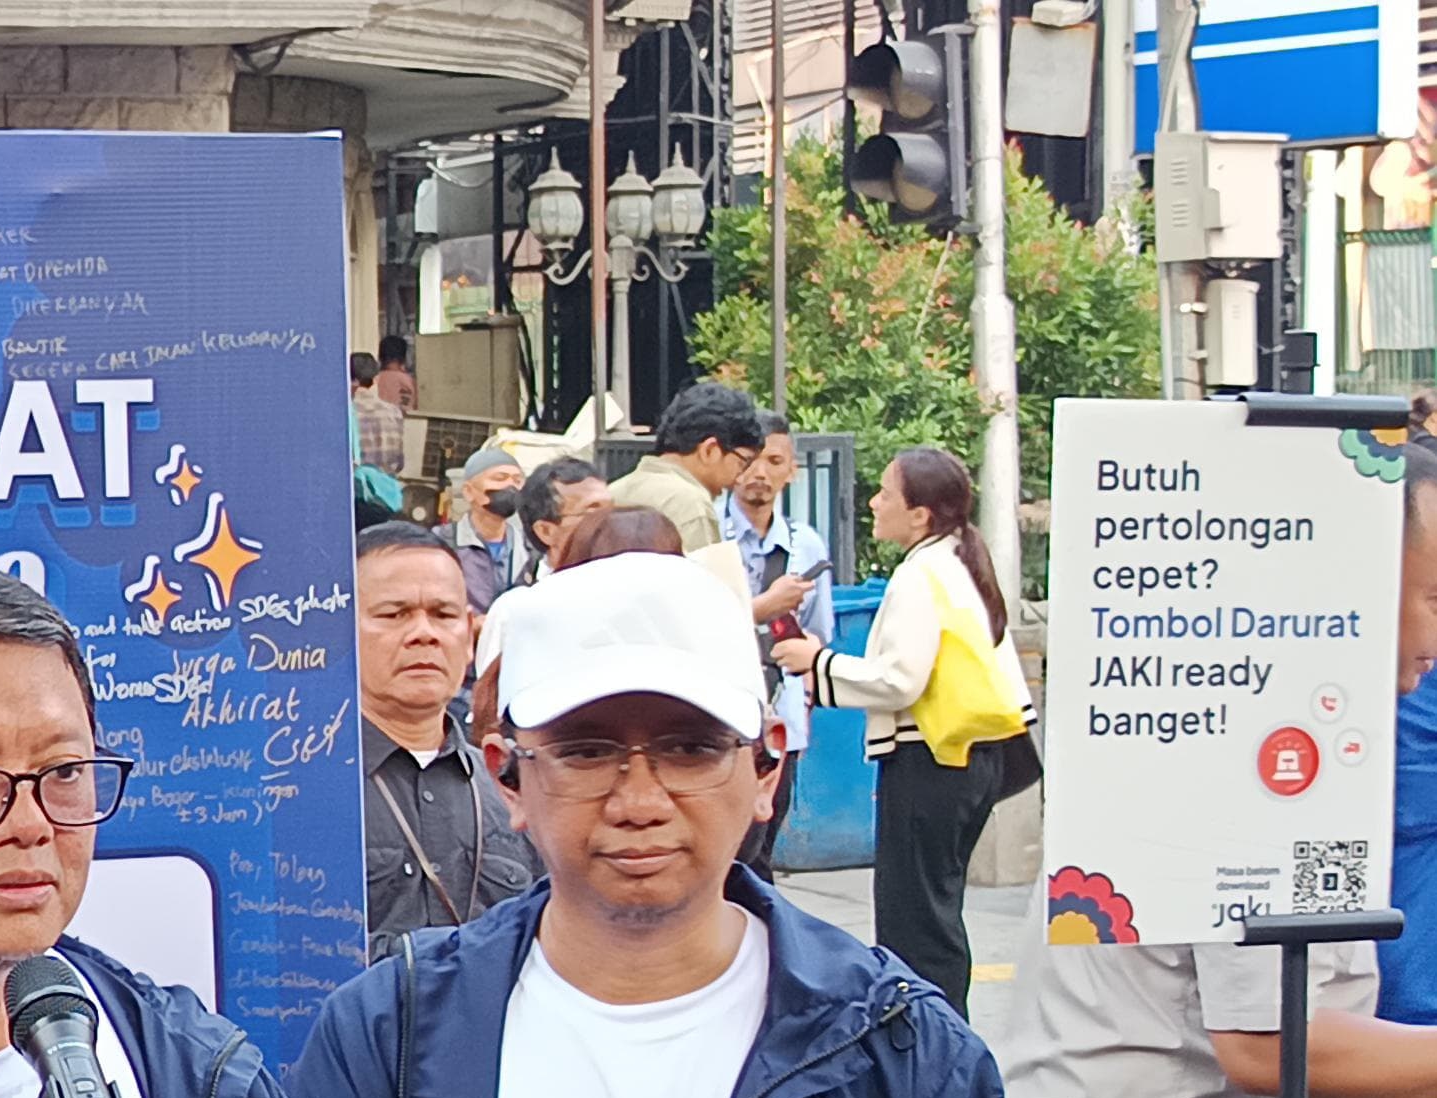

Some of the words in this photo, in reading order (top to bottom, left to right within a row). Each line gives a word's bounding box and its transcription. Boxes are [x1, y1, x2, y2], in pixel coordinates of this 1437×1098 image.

[1096, 459, 1202, 493] Butuh
[1093, 508, 1315, 550] pertolongan
[1091, 558, 1220, 598] cepet?
[1089, 606, 1224, 642] Tombol
[1230, 607, 1362, 641] Darurat
[1088, 654, 1164, 690] JAKI
[1170, 654, 1275, 695] ready
[1088, 703, 1229, 745] banget!
